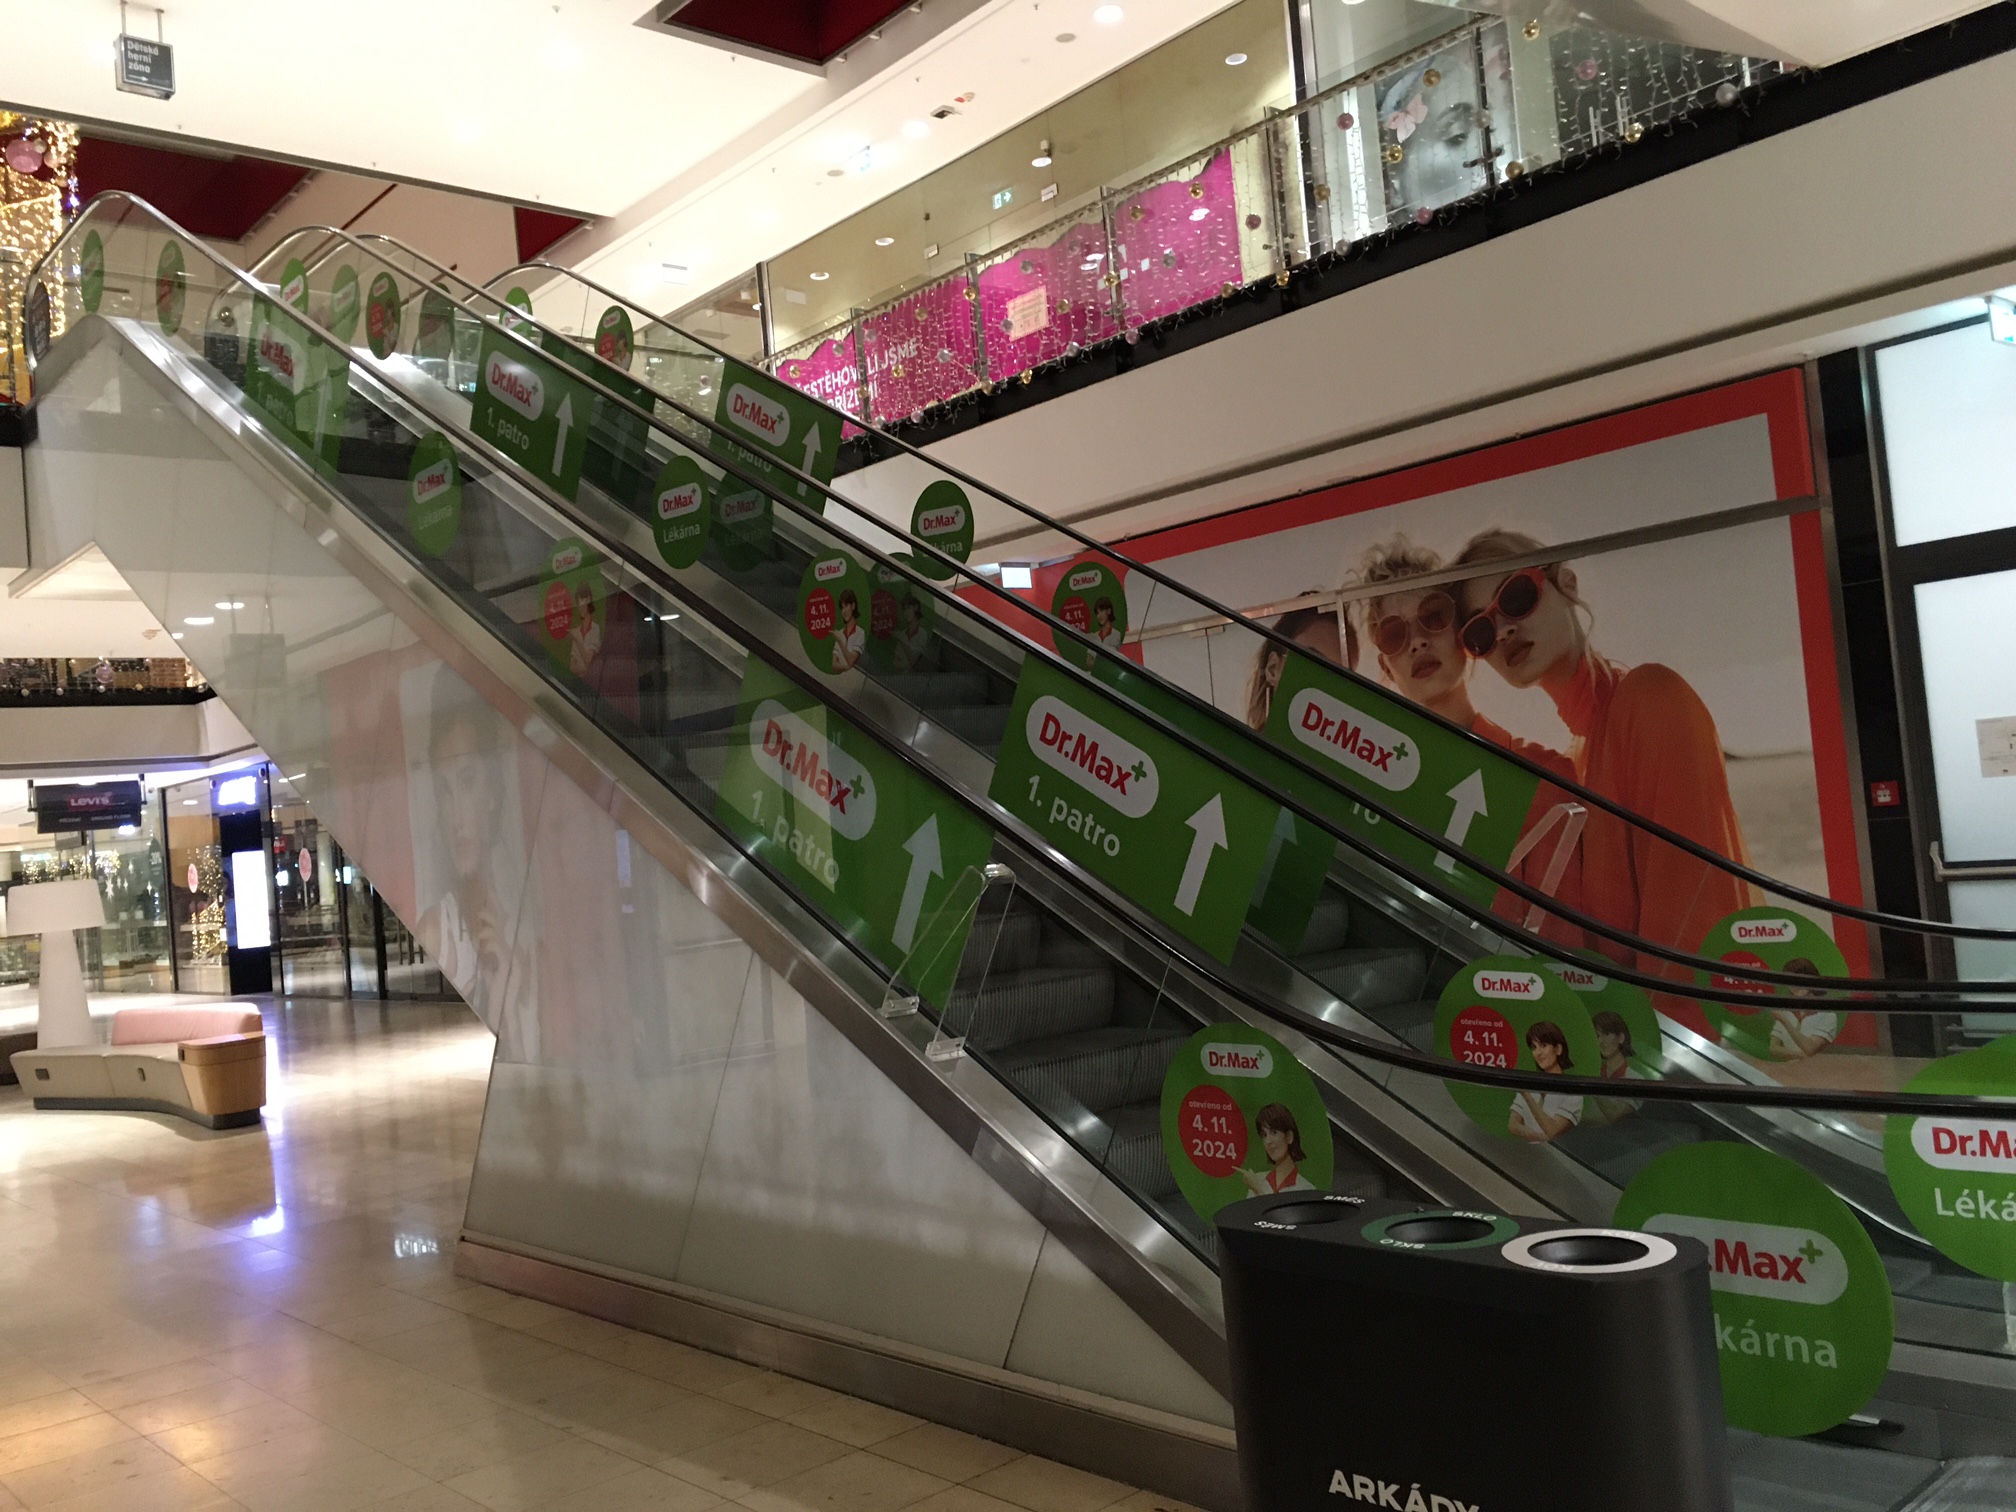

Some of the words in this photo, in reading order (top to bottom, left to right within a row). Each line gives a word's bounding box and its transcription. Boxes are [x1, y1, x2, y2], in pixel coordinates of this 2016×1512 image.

[497, 417, 530, 451] patro
[663, 523, 701, 544] Lékárna
[810, 616, 832, 631] 2024
[1027, 774, 1043, 808] 1.
[1049, 794, 1122, 858] patro
[772, 814, 841, 886] patro
[1463, 1050, 1507, 1069] 2024
[1222, 1102, 1233, 1112] od
[1192, 1138, 1237, 1160] 2024
[1713, 1312, 1838, 1369] kárna
